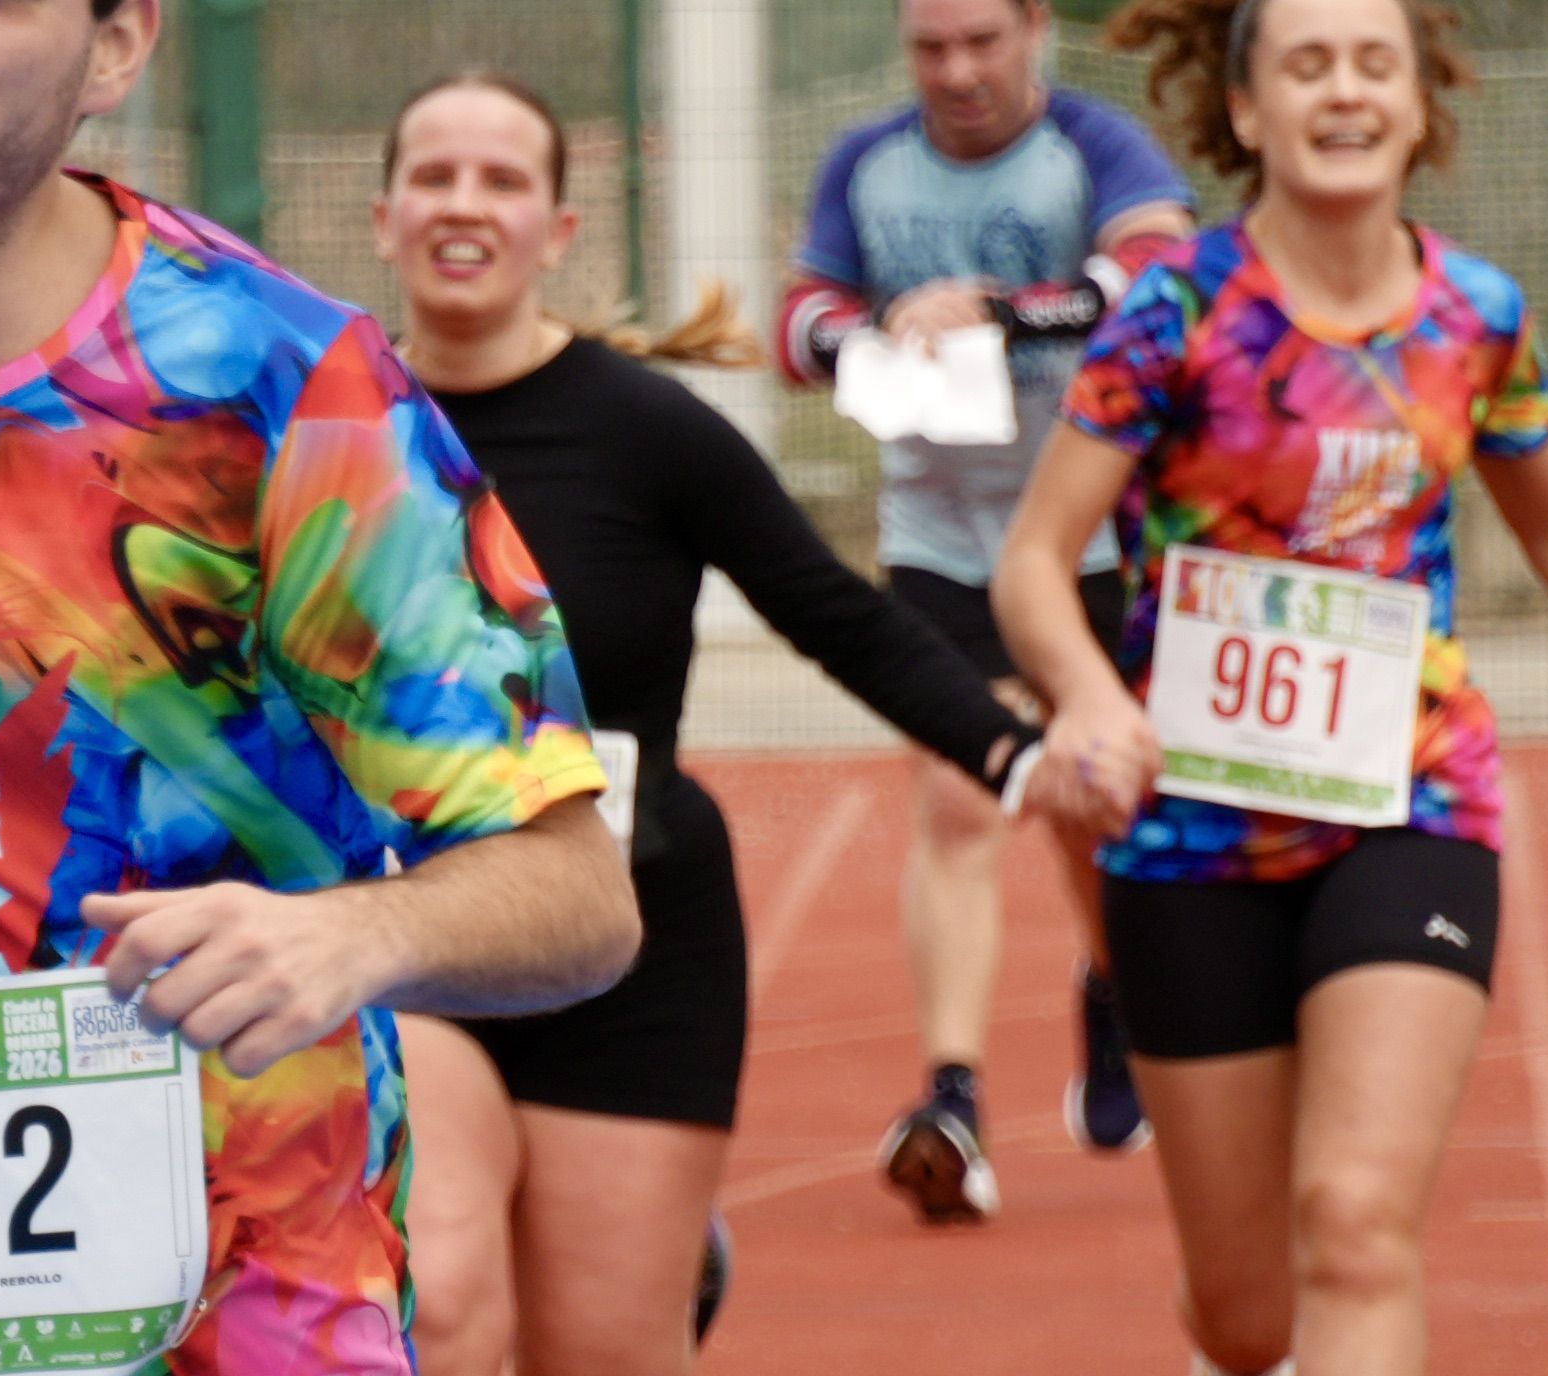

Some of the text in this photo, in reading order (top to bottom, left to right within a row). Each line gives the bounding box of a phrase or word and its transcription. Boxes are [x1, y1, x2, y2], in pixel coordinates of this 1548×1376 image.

[1212, 634, 1351, 740] 961
[6, 1049, 64, 1081] 2026
[0, 1273, 62, 1287] REBOLLO
